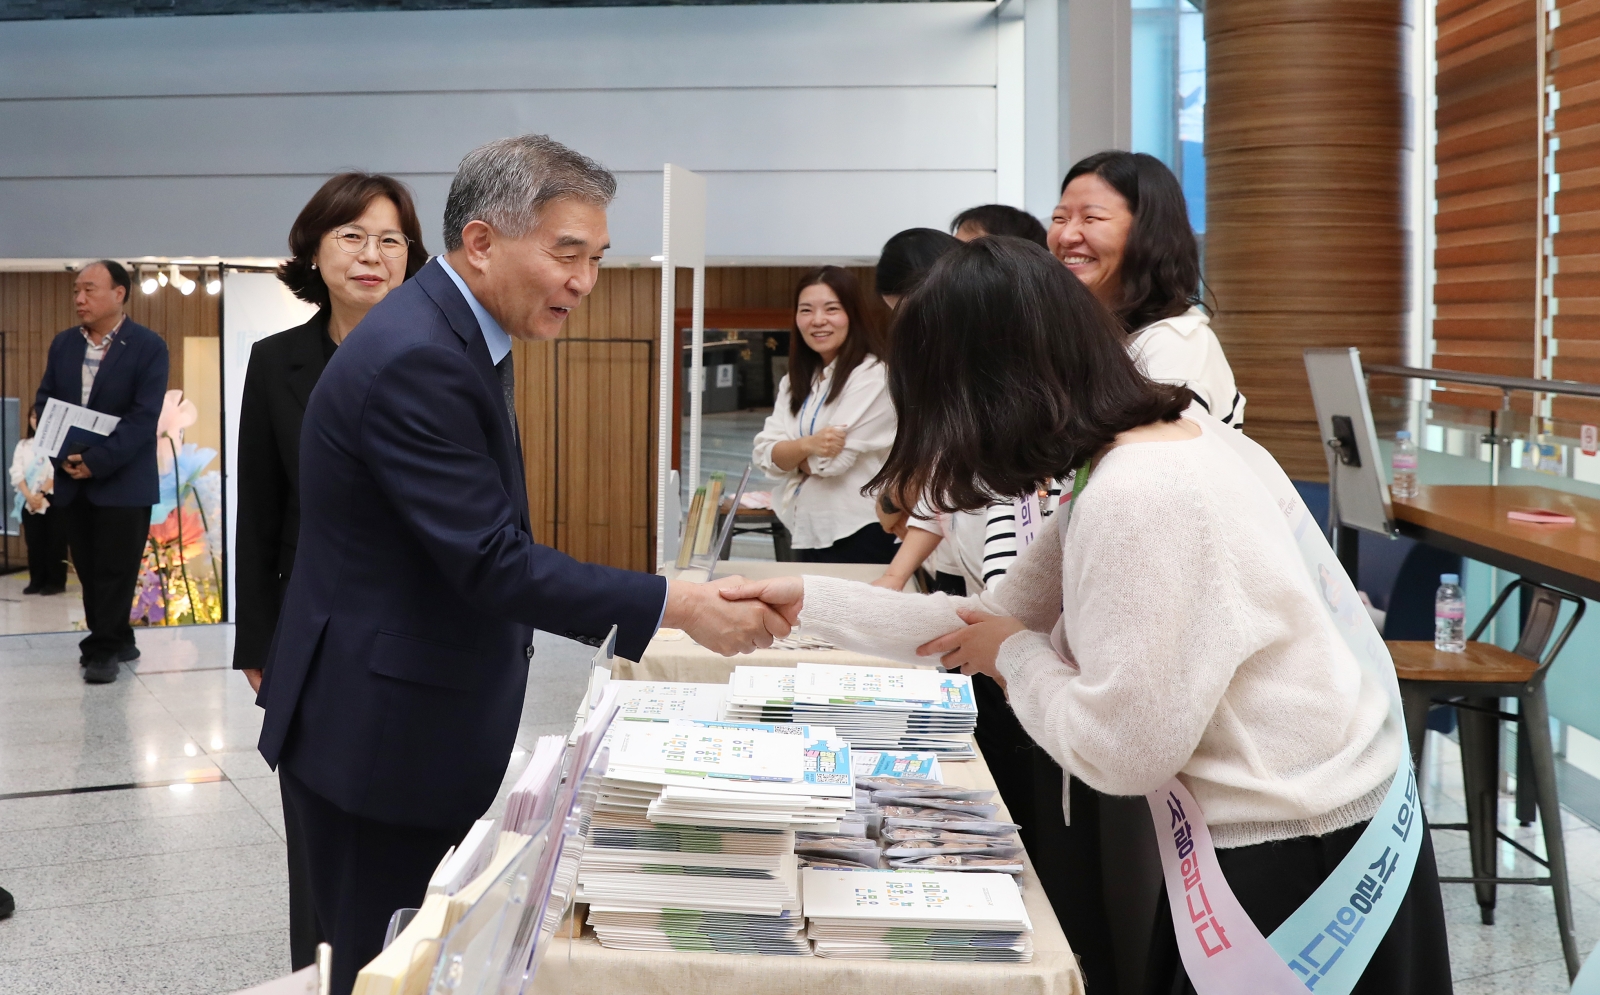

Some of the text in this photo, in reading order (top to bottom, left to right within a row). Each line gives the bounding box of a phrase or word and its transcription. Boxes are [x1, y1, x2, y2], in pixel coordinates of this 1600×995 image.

[662, 734, 688, 762] 지원센터
[694, 736, 723, 764] 육아종합
[732, 739, 754, 758] 강남구
[1167, 790, 1232, 958] 사랑입니다
[855, 888, 878, 906] 강남구
[886, 880, 914, 907] 육아종합
[922, 881, 950, 908] 지원센터
